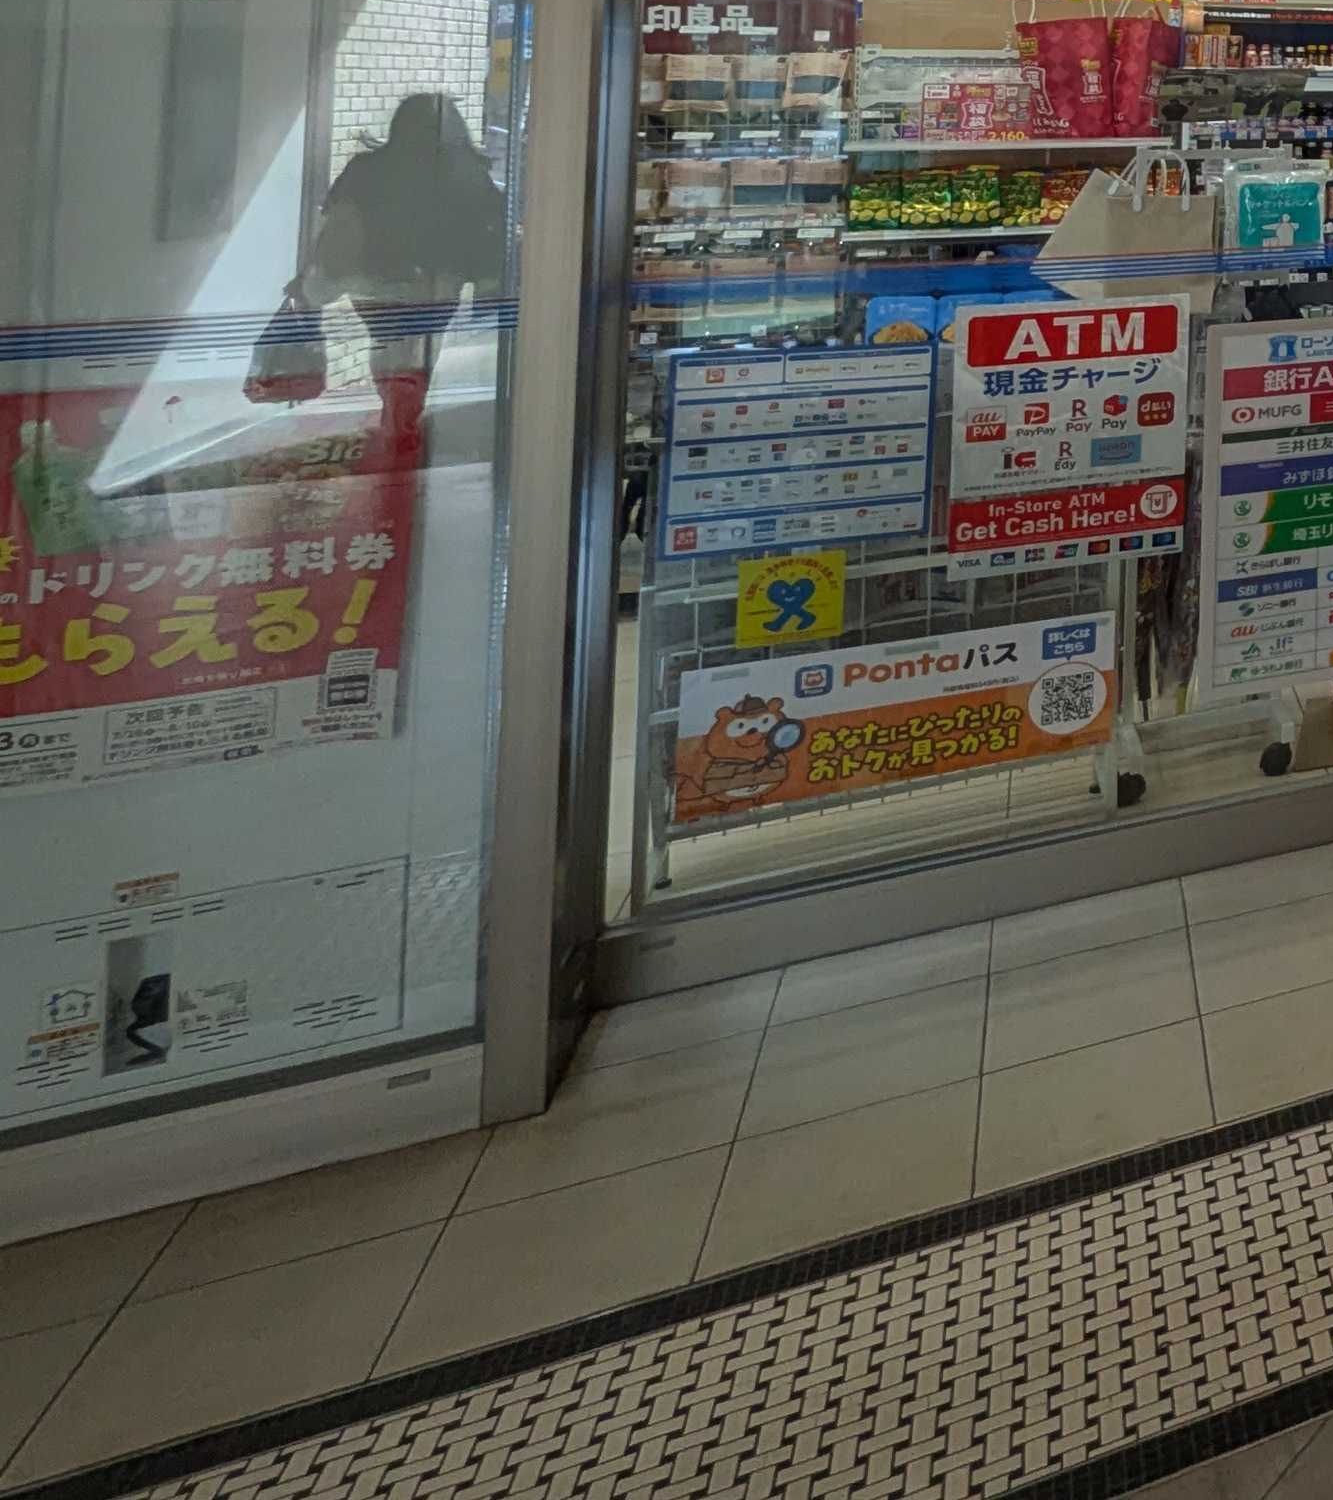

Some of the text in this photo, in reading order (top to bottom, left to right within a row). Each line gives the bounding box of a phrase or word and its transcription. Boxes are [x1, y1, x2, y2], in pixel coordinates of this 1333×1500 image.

[1003, 311, 1146, 361] ATM
[983, 357, 1161, 397] 現金チャージ
[971, 411, 1001, 424] au
[1257, 404, 1302, 419] MUFG
[972, 425, 1001, 438] PAY
[1015, 425, 1057, 438] PayPay
[1065, 420, 1093, 434] Pay
[1101, 416, 1129, 431] Pay
[1053, 457, 1077, 472] Edy
[988, 491, 1106, 518] In-Store ATM
[954, 503, 1137, 543] Get Cash Here!
[29, 532, 397, 605] ドリンク無料券
[956, 557, 983, 570] VISA
[1236, 584, 1258, 597] SBI
[1256, 598, 1297, 612] ソニー銀行
[1046, 626, 1092, 644] 詳しくは
[1053, 639, 1086, 657] こちら
[842, 638, 1019, 689] Pontaパス
[808, 701, 1023, 757] あなたにぴったりの
[806, 724, 1019, 784] おトクが見つかる!
